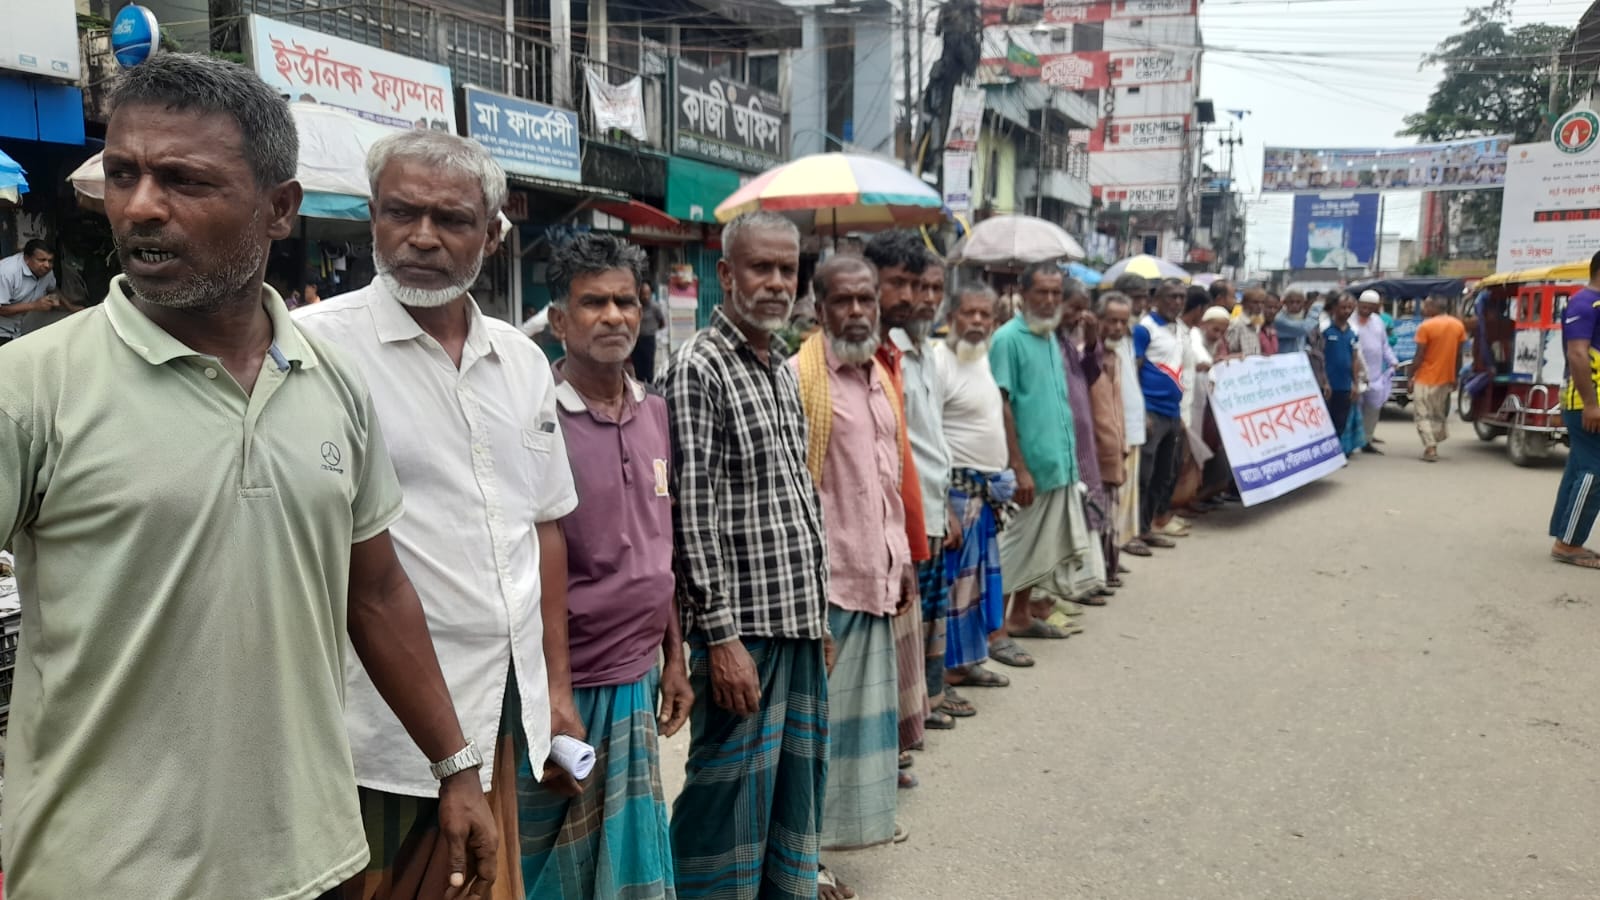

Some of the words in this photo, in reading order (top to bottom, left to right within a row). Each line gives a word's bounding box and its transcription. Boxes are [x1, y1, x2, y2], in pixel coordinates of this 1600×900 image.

[269, 33, 363, 94] ইউনিক
[369, 70, 445, 113] ফ্যাশন
[473, 101, 501, 133] মা
[504, 110, 574, 148] ফার্মেসী
[679, 79, 729, 140] কাজী
[731, 95, 782, 155] অফিস
[1128, 188, 1176, 203] PREMIER
